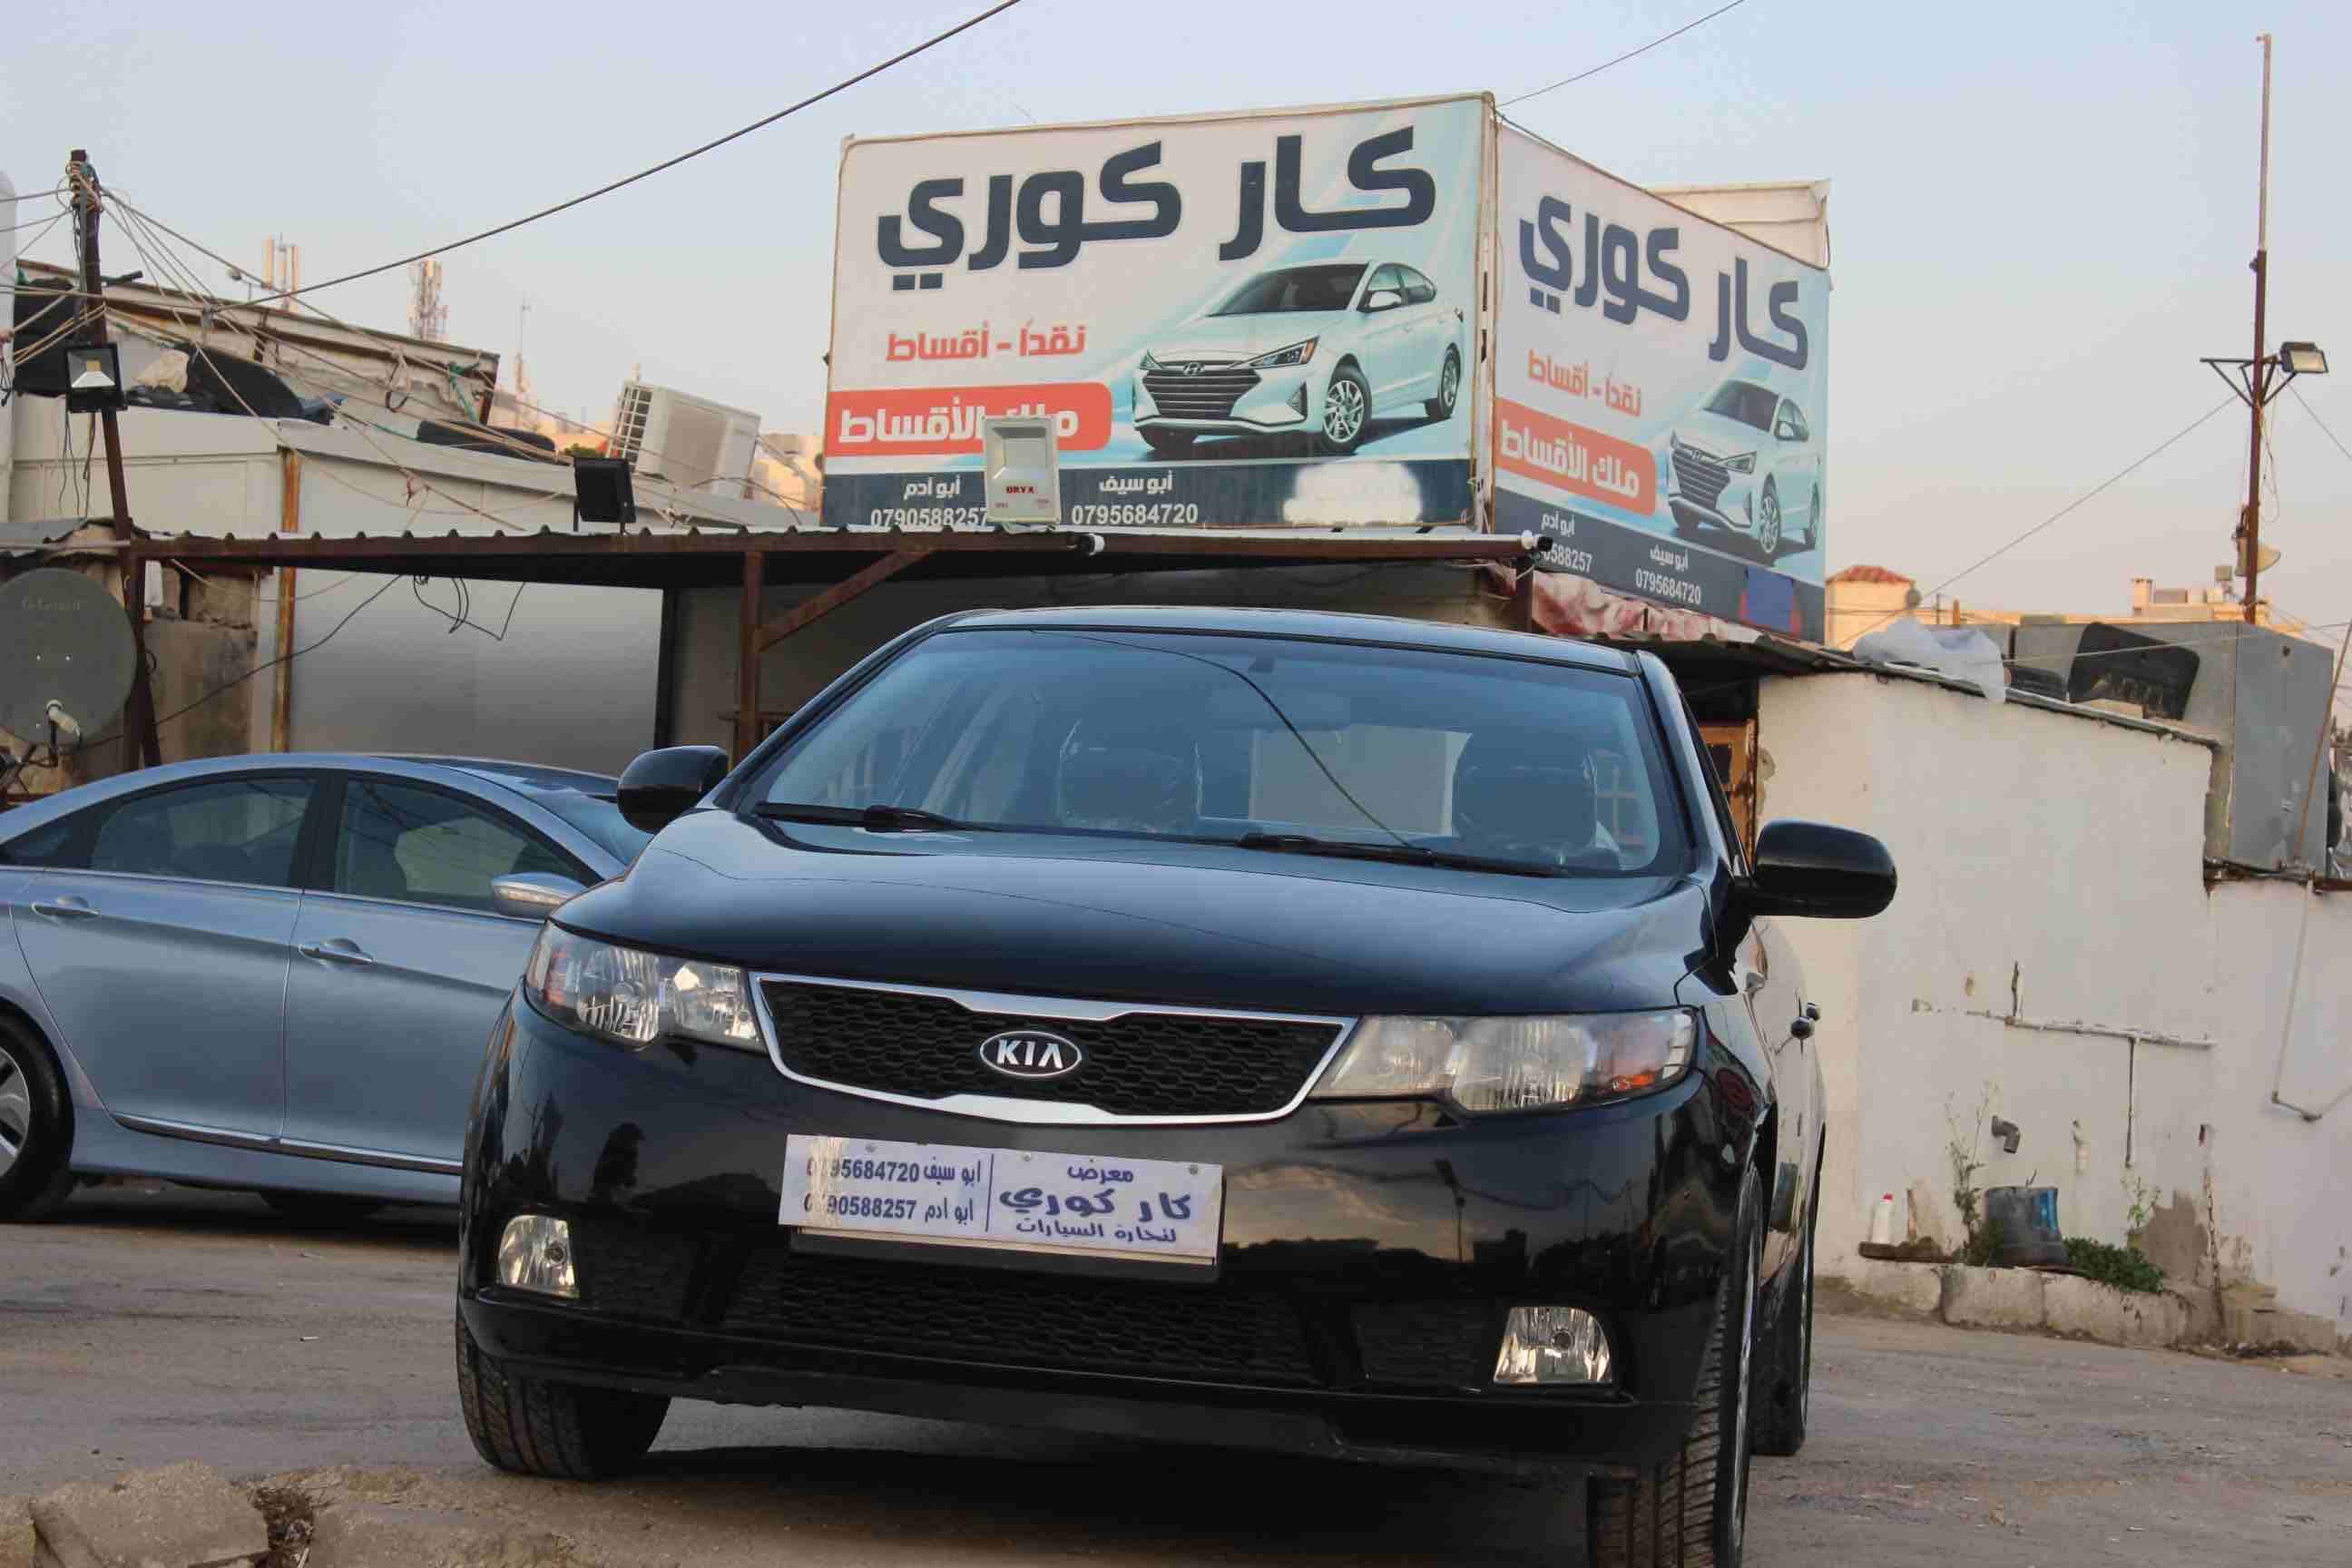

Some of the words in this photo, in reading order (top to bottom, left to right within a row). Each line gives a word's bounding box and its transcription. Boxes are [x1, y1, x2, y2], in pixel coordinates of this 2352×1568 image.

[1219, 125, 1436, 261] كار
[877, 140, 1183, 291] كوري
[1519, 195, 1690, 325] كوري
[1709, 256, 1808, 370] كار
[886, 320, 988, 362] أقساط
[1527, 348, 1588, 398] أقساط
[838, 396, 985, 443] الأقساط
[1500, 419, 1588, 483] الأقساط
[936, 475, 961, 498] أبو
[1099, 475, 1144, 495] سيف
[1146, 470, 1173, 495] أبو
[1592, 455, 1640, 498] ملك
[1072, 504, 1199, 524] 0795684720
[1650, 544, 1674, 566] سيف
[1635, 568, 1701, 605] 0795684720
[996, 1039, 1063, 1069] KIA
[924, 1155, 956, 1186] سيف
[925, 1197, 948, 1223] ادم
[999, 1187, 1116, 1217] كوري
[1138, 1191, 1191, 1222] كار
[1015, 1217, 1104, 1238] السيارات
